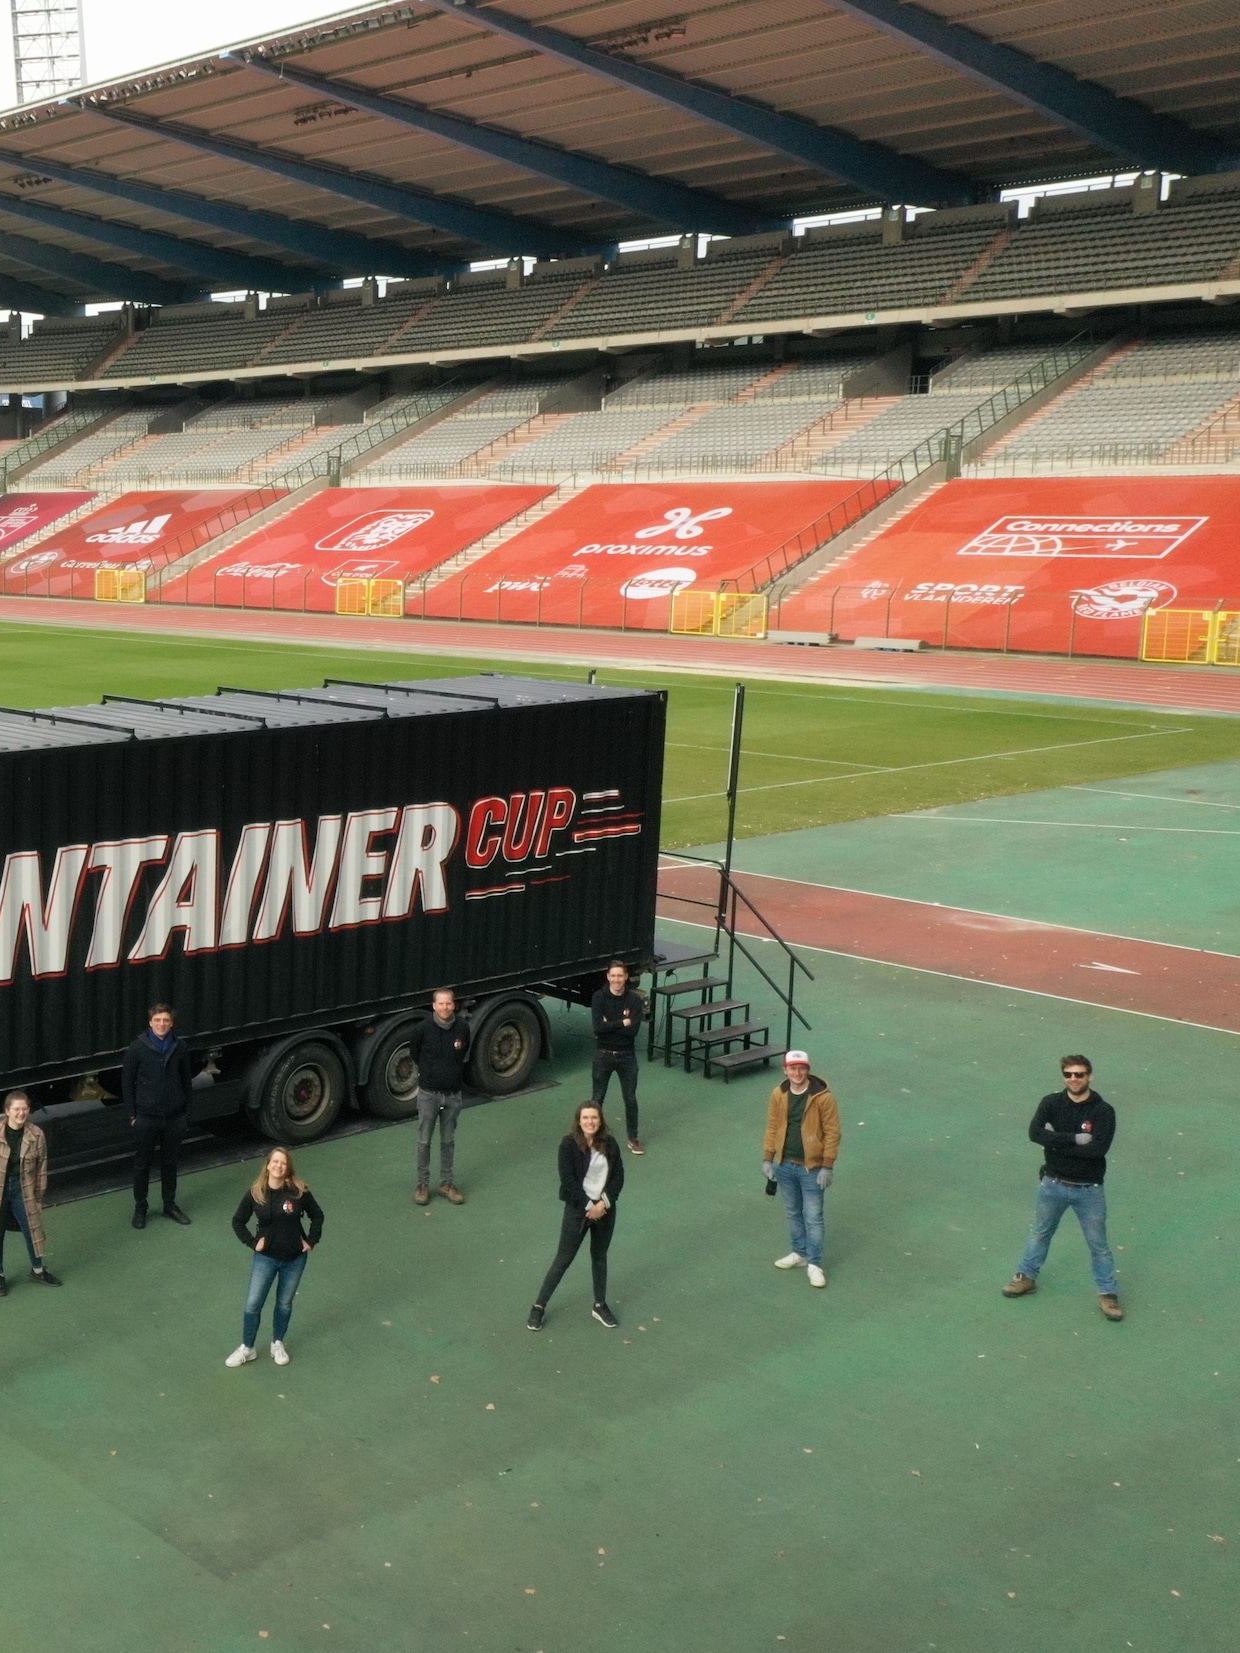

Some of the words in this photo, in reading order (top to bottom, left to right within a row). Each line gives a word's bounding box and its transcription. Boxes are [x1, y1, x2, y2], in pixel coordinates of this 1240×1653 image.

[1006, 521, 1181, 533] Connections
[85, 528, 160, 544] adidas
[572, 543, 713, 556] proximus
[483, 581, 550, 593] pwc
[1109, 581, 1168, 591] BELGIAN
[904, 593, 1020, 605] VLAANDEREN
[465, 786, 577, 869] CUP
